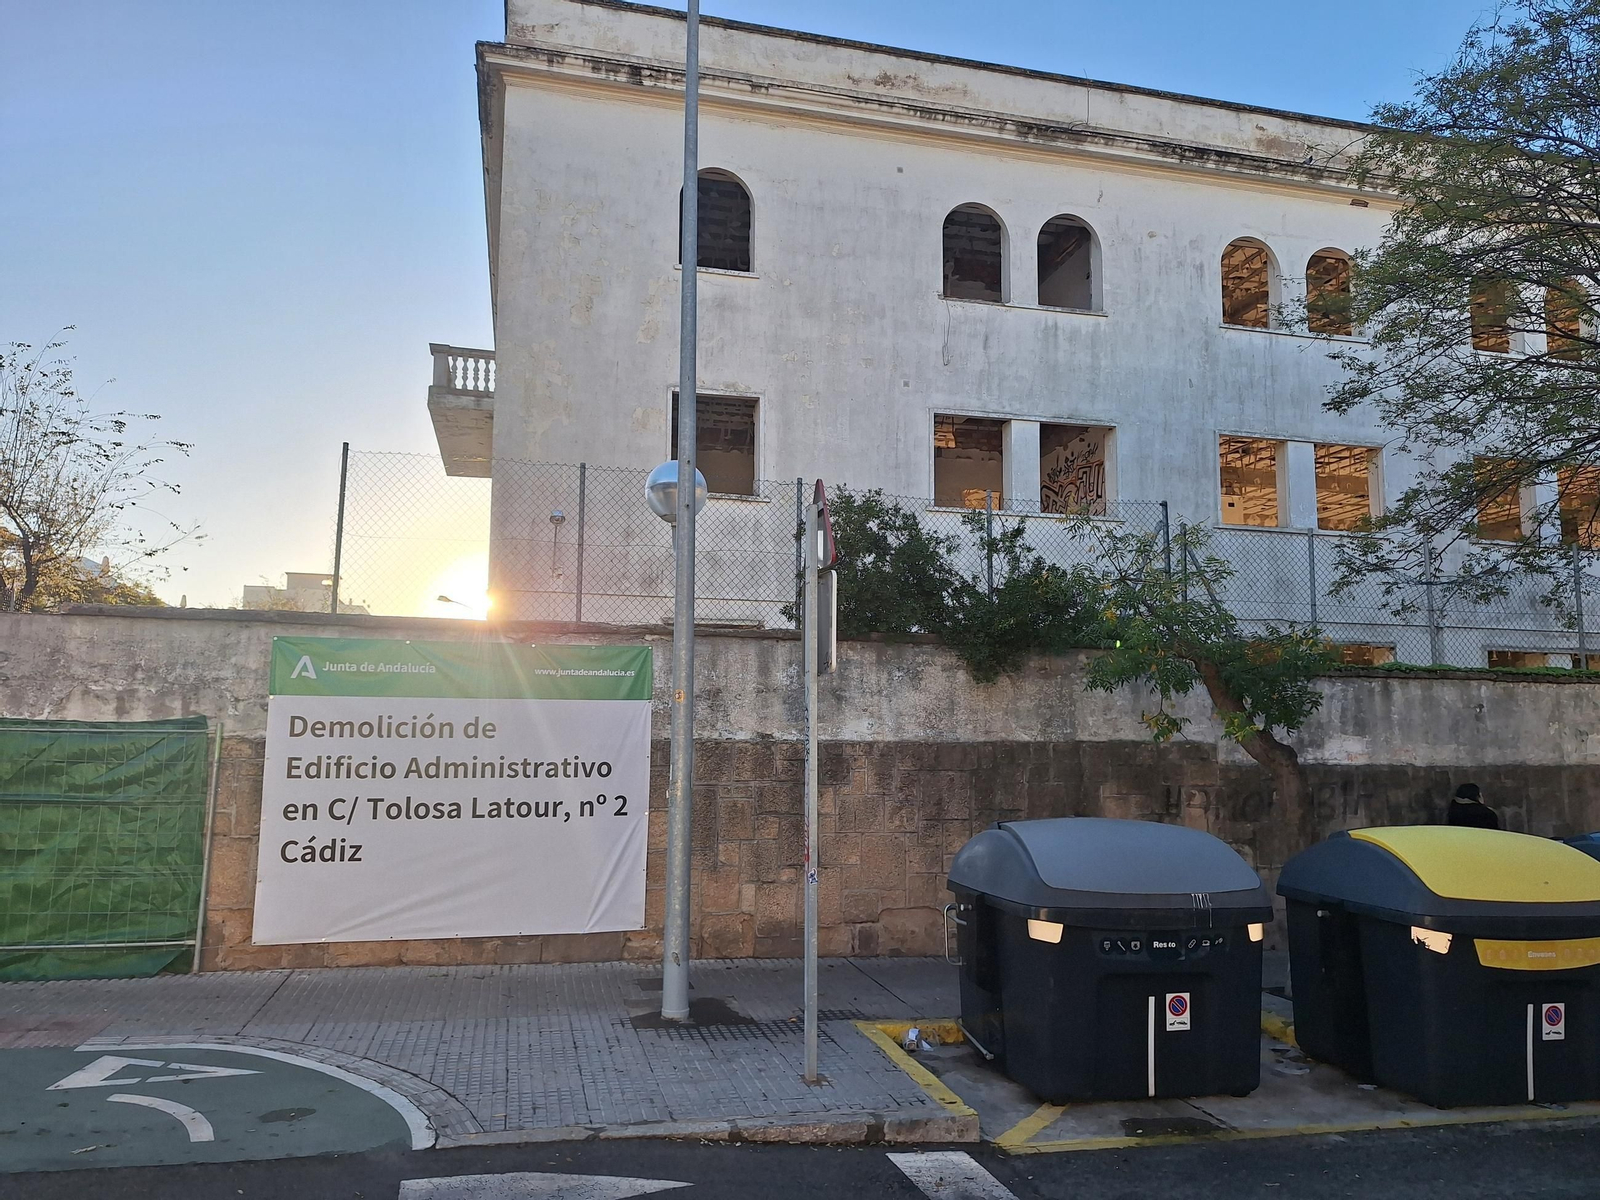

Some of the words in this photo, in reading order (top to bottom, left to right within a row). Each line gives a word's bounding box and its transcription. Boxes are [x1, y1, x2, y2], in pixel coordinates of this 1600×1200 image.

[322, 661, 357, 672] Junta
[359, 662, 375, 673] de
[377, 662, 436, 674] Andalucía
[534, 667, 635, 677] www.juntadeandalucia.es
[289, 713, 455, 739] Demolición
[463, 716, 497, 739] de
[286, 755, 397, 779] Edificio
[404, 755, 613, 779] Administrativo
[282, 802, 319, 821] en
[328, 796, 359, 825] C/
[367, 796, 462, 820] Tolosa
[471, 797, 571, 823] Latour,
[613, 795, 628, 816] 2
[280, 835, 363, 863] Cádiz
